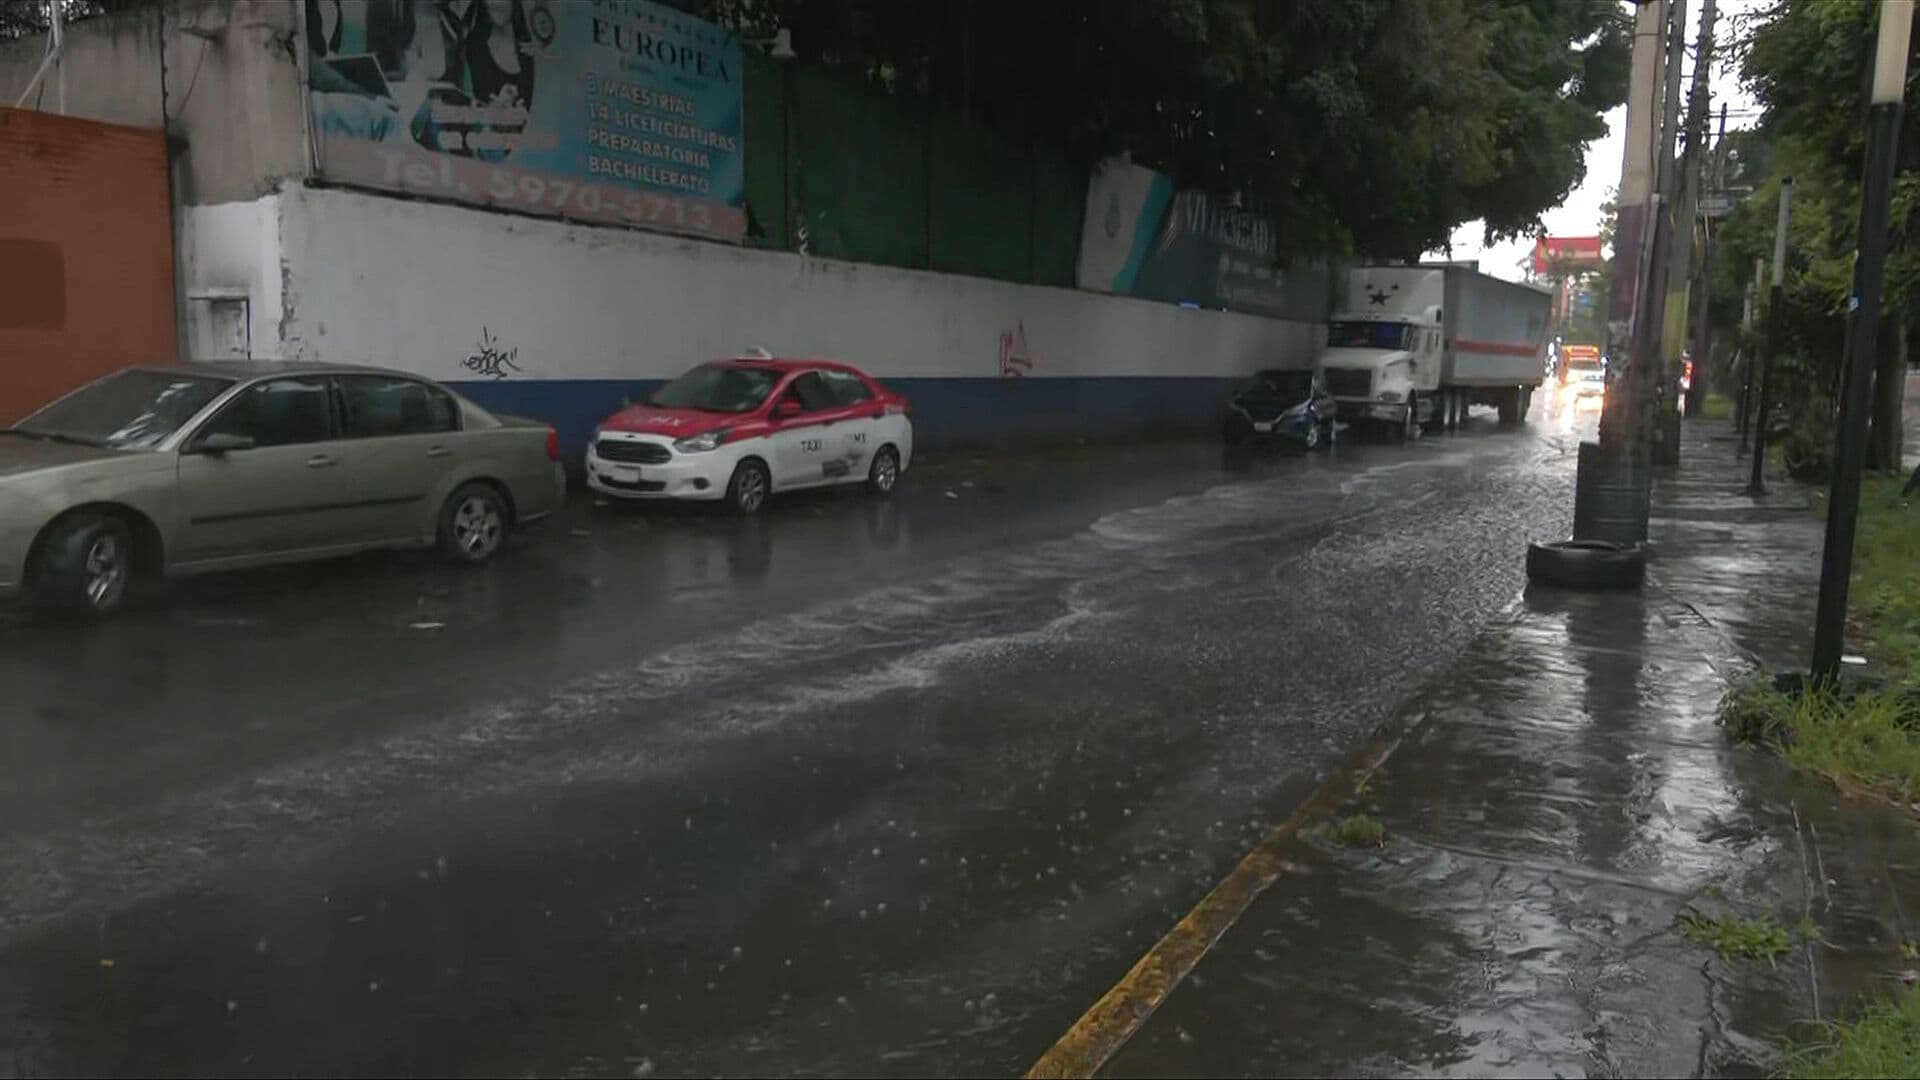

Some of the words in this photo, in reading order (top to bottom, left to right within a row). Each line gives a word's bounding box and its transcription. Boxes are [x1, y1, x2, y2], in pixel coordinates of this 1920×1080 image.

[593, 17, 731, 82] EUROPEA
[588, 127, 711, 169] PREPARATORIA
[615, 110, 737, 152] LICENCIATURAS
[376, 147, 468, 192] Tel.
[488, 171, 713, 227] 5970-5713
[588, 155, 710, 193] BACHILLERATO
[801, 440, 822, 453] TAXI
